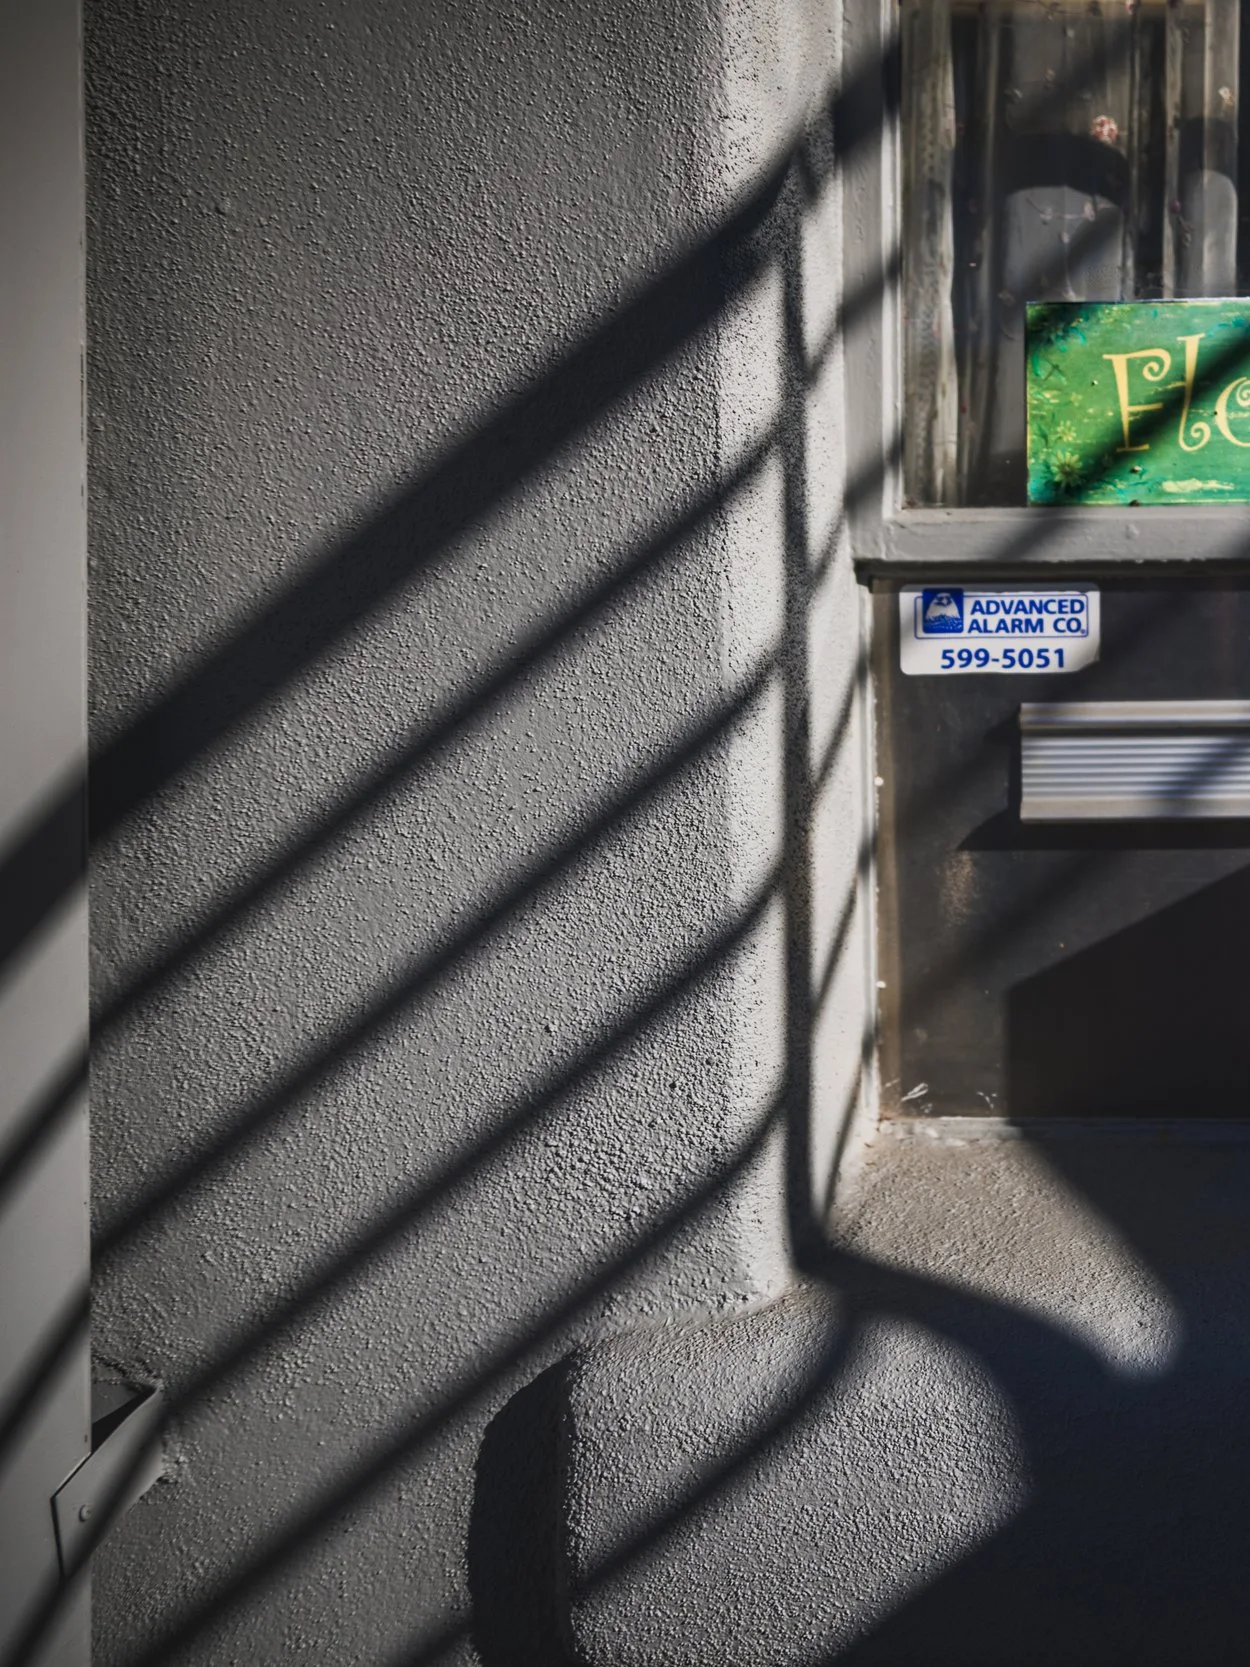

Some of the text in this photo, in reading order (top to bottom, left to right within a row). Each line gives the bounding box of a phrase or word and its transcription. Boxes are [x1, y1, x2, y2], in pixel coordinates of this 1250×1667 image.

[970, 599, 1085, 615] ADVANCED
[967, 618, 1044, 634] ALARM
[940, 648, 1064, 669] 599-5051
